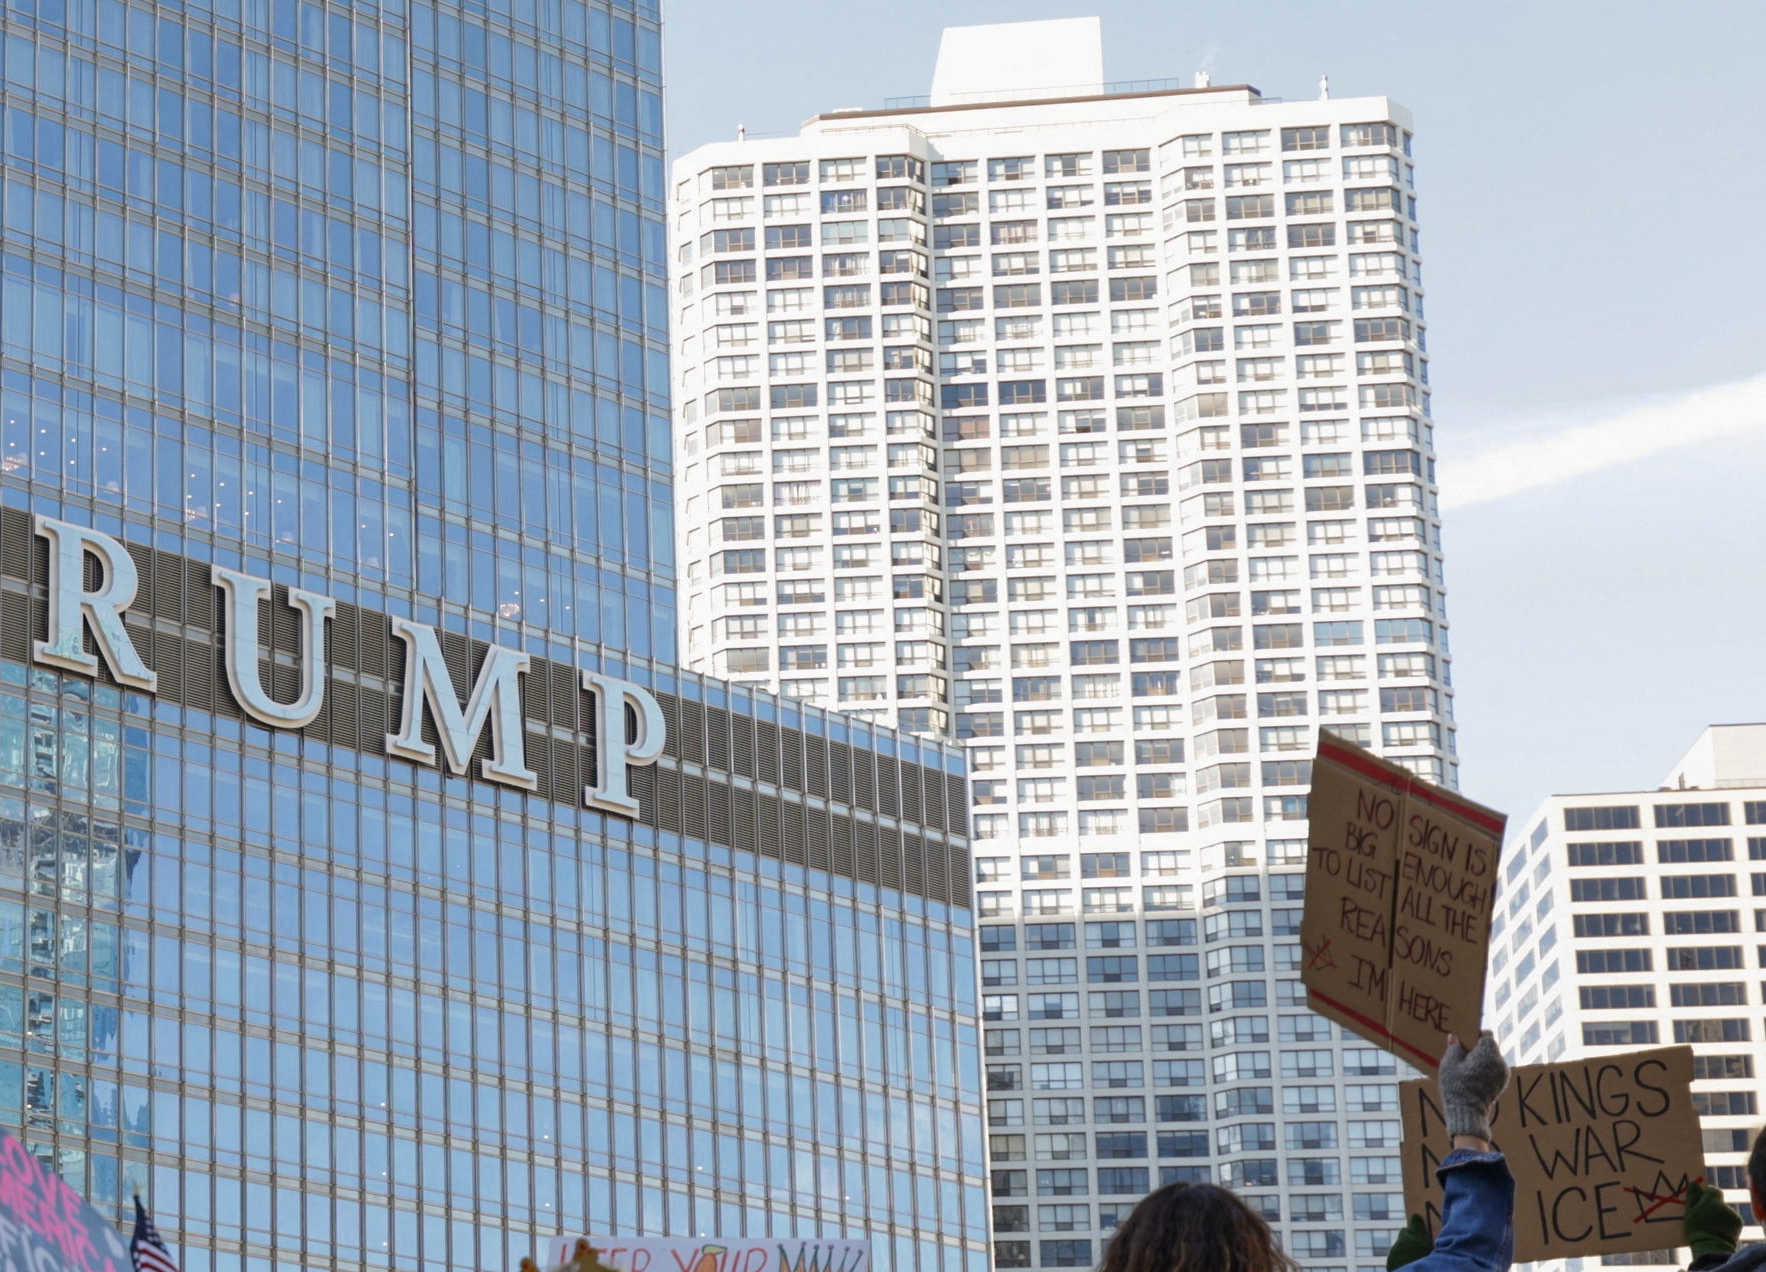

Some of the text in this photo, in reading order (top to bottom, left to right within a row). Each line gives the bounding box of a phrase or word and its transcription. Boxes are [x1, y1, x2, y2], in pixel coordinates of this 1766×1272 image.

[1357, 788, 1487, 876] NO SIGN IS
[1311, 847, 1478, 945] TO LIST ALL THE
[1345, 822, 1487, 915] BIG ENOUGH
[1398, 980, 1452, 1034] HERE
[1516, 1060, 1670, 1128] KINGS
[1529, 1120, 1664, 1180] WAR
[1537, 1181, 1632, 1245] ICE
